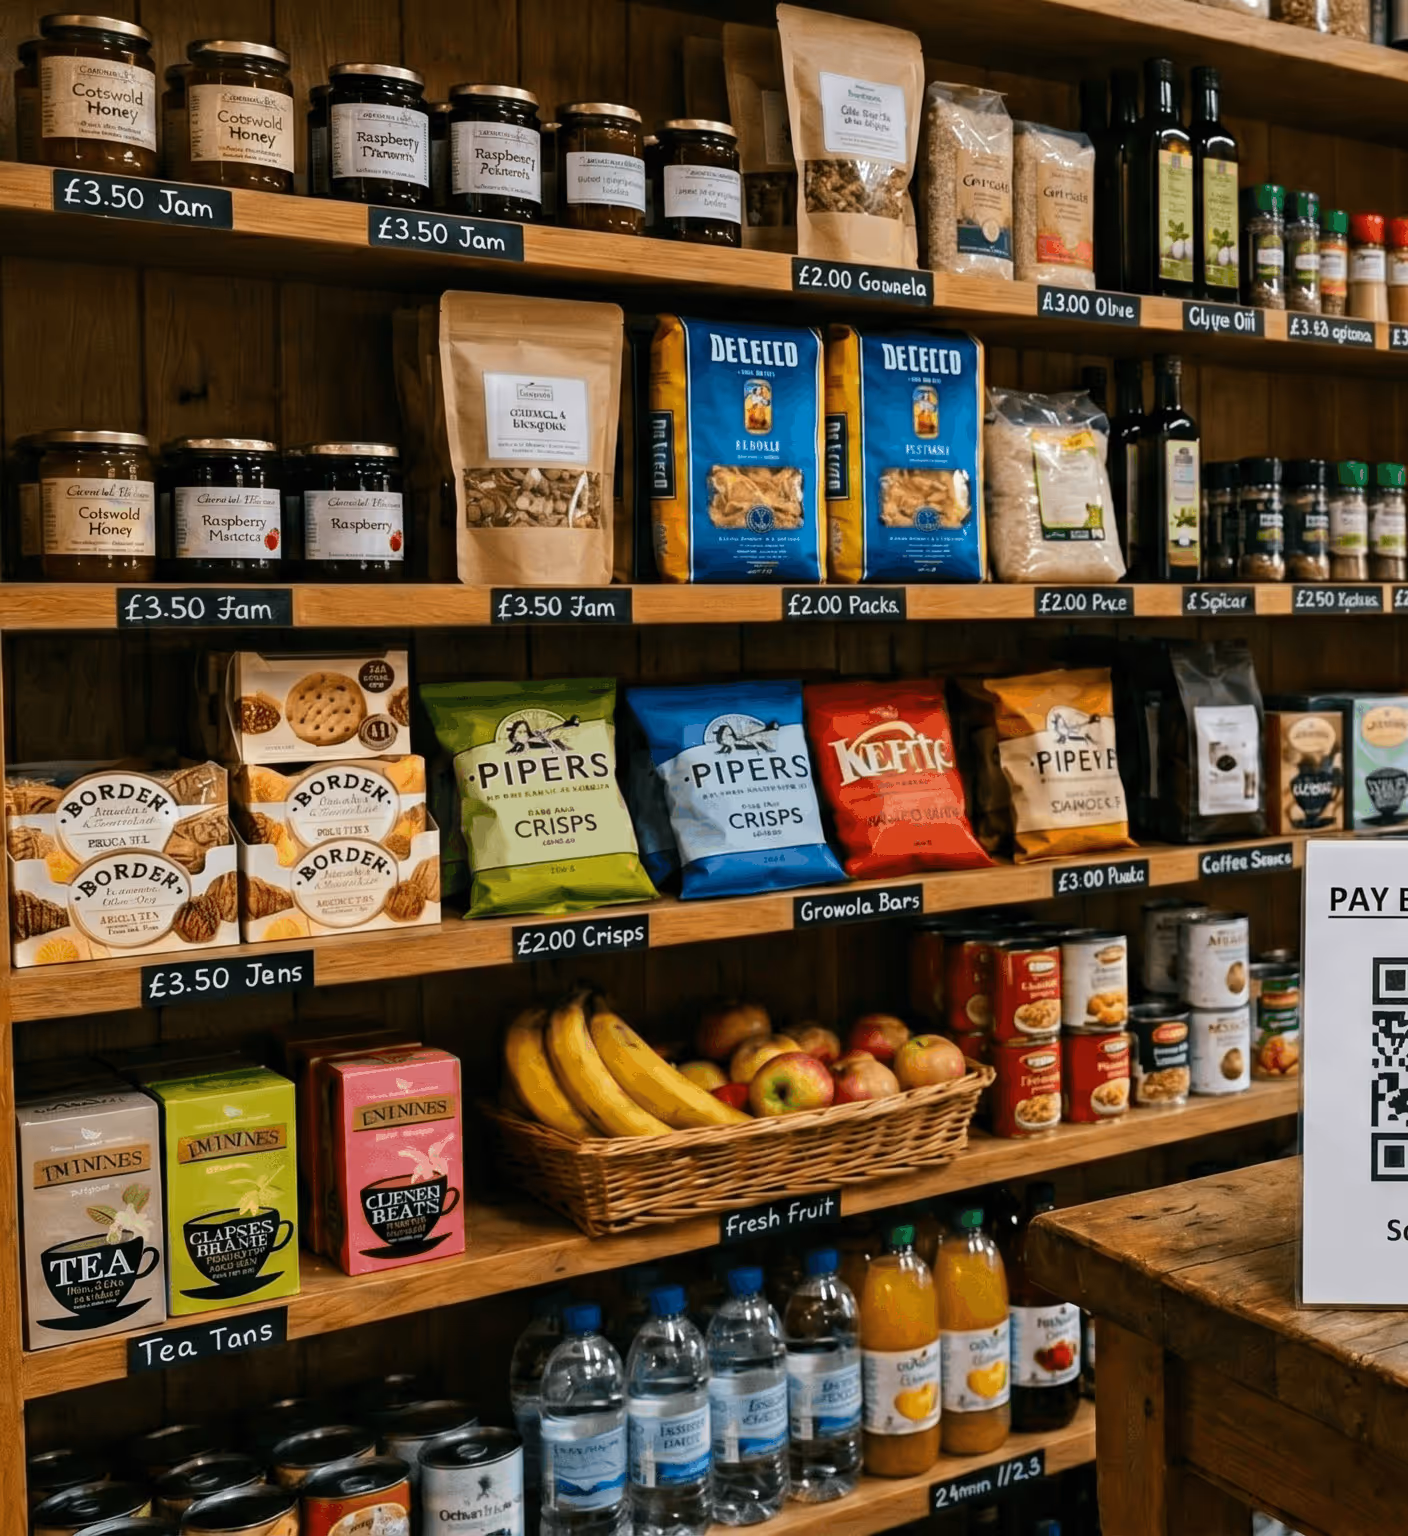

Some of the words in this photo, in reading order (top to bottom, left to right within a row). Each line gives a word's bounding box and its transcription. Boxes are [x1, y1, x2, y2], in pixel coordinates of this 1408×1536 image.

[72, 83, 143, 106] Cotswold
[85, 99, 139, 125] Honey
[229, 126, 276, 148] Honey
[64, 178, 145, 210] £3.50
[158, 189, 213, 219] Jam
[378, 216, 448, 244] £3.50
[458, 226, 506, 251] Jam
[799, 265, 852, 289] £2.00
[78, 506, 140, 521] Cotswold
[202, 515, 267, 531] Raspberry
[331, 518, 393, 534] Raspberry
[89, 522, 132, 537] Honey
[124, 594, 205, 622] £3.50
[498, 594, 562, 620] £3.50
[788, 594, 842, 615] £2.00
[1038, 592, 1087, 613] £2.00
[478, 753, 609, 789] PIPERS
[692, 755, 808, 789] PIPERS
[514, 814, 597, 838] CRISPS
[728, 807, 804, 829] CRISPS
[1329, 886, 1389, 913] PAY
[517, 929, 576, 956] £2.00
[582, 924, 645, 948] Crisps
[149, 967, 230, 998] £3.50
[245, 964, 303, 988] Jens
[50, 1248, 135, 1287] TEA
[138, 1337, 197, 1366] Tea
[210, 1322, 273, 1351] Tans
